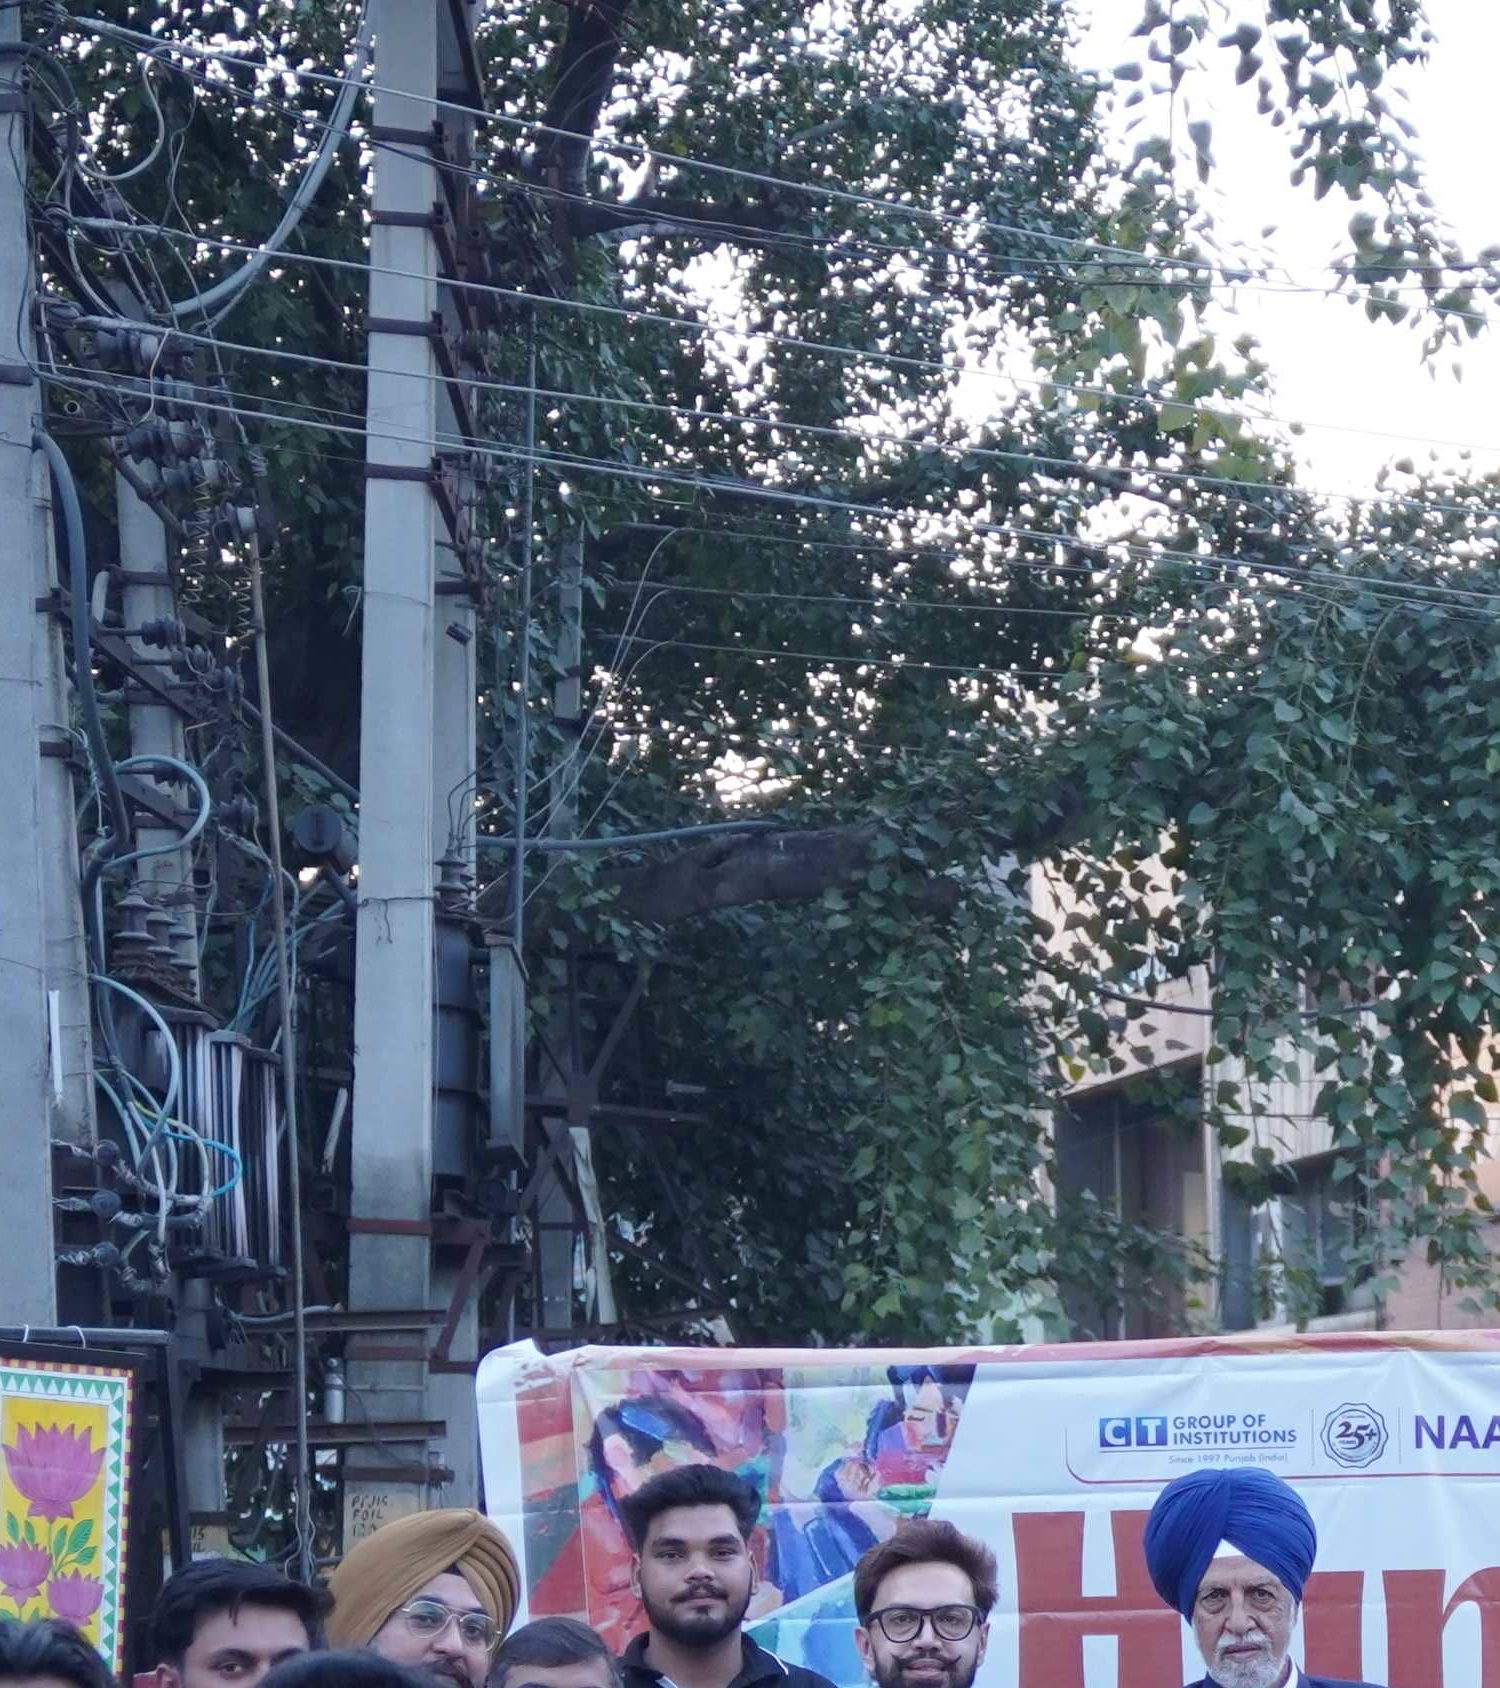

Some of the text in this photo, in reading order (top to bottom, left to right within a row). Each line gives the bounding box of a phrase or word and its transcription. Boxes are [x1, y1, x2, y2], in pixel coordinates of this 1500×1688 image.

[1104, 1414, 1266, 1446] CT GROUP OF
[1173, 1429, 1297, 1445] INSTITUTIONS
[1335, 1420, 1377, 1450] 25+
[1168, 1453, 1194, 1464] Since
[1199, 1453, 1221, 1464] 1997
[1223, 1453, 1255, 1465] Punjab
